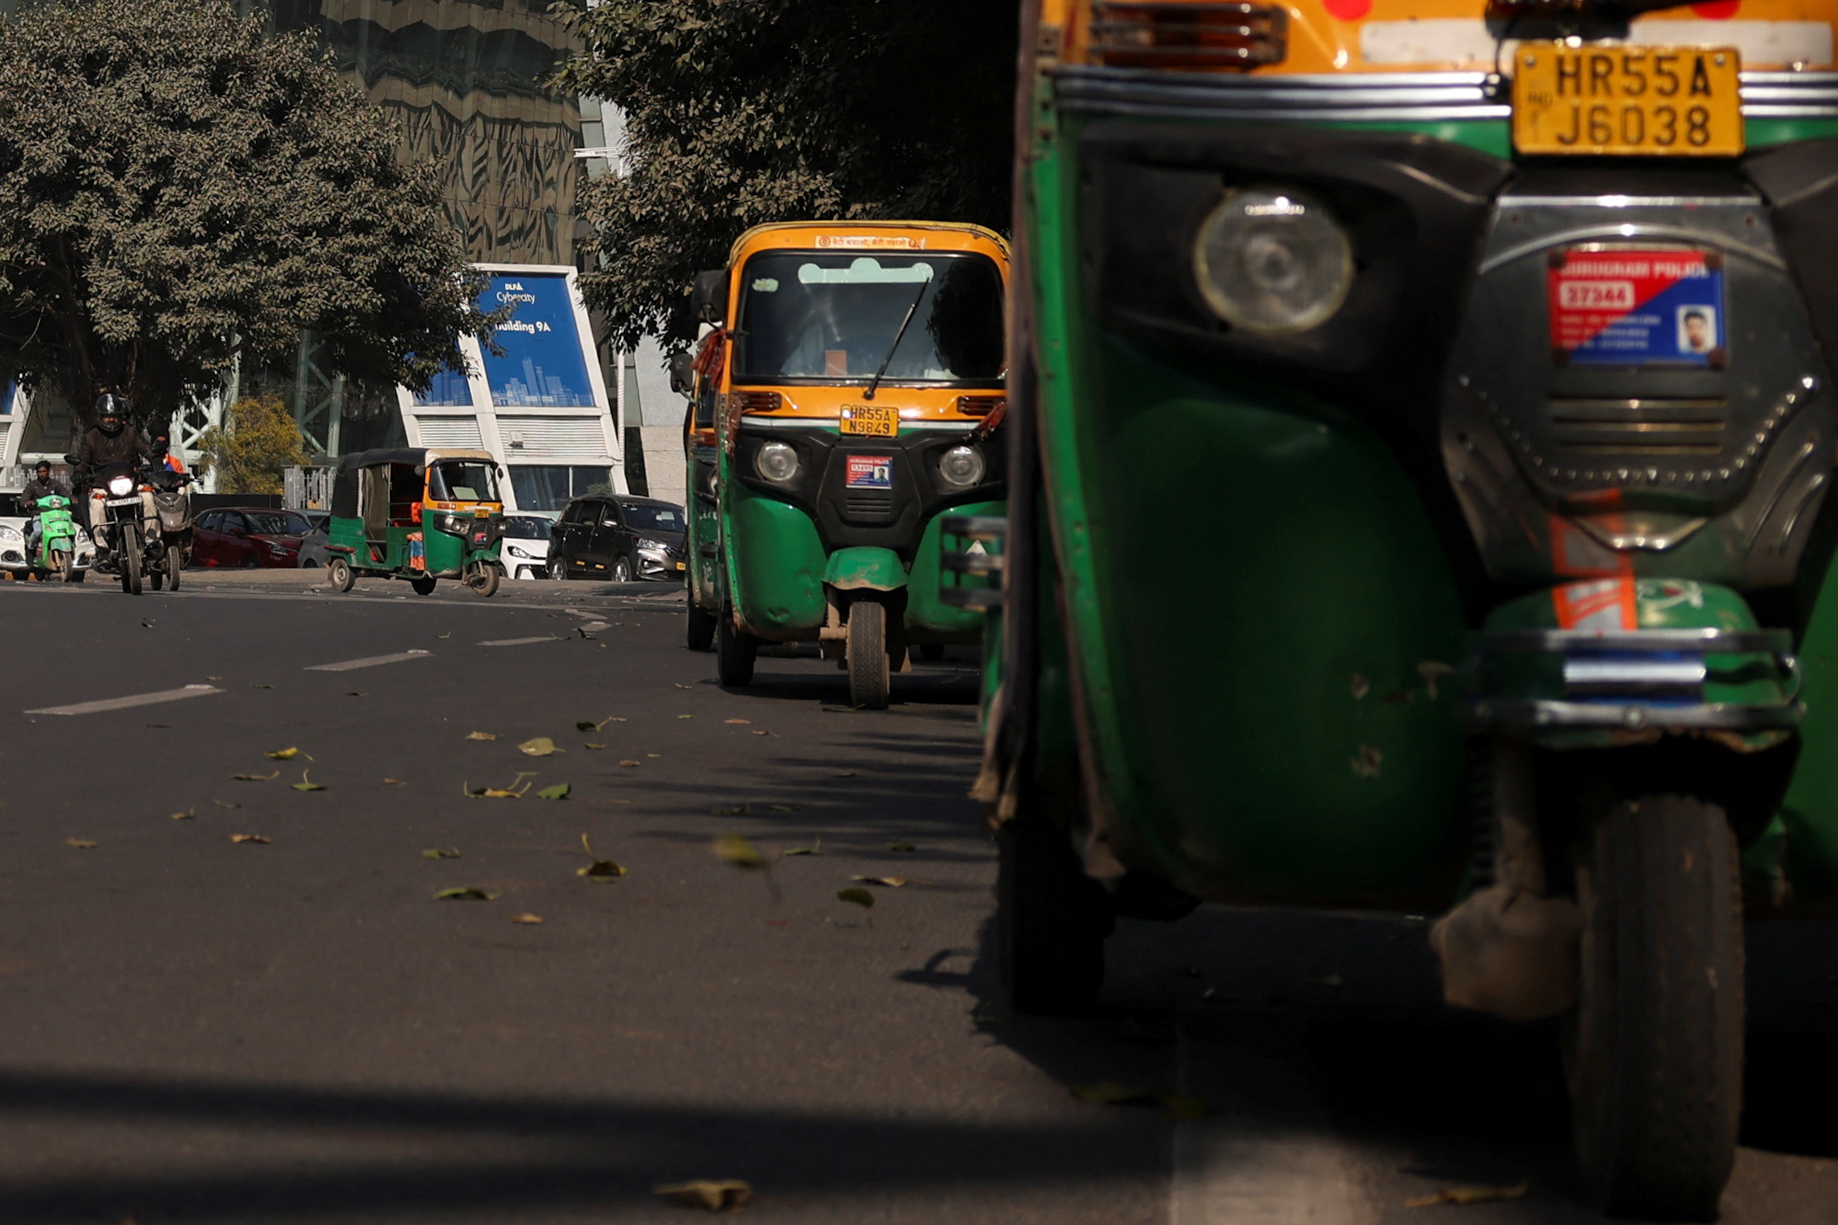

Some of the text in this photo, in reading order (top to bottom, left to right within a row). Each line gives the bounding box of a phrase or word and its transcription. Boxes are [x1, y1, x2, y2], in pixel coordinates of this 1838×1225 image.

[1555, 55, 1712, 97] HR55A
[1556, 105, 1711, 147] J6038
[496, 291, 536, 304] Cybercity
[536, 321, 551, 332] 9A
[851, 406, 890, 422] HR55A
[849, 420, 890, 434] N9849
